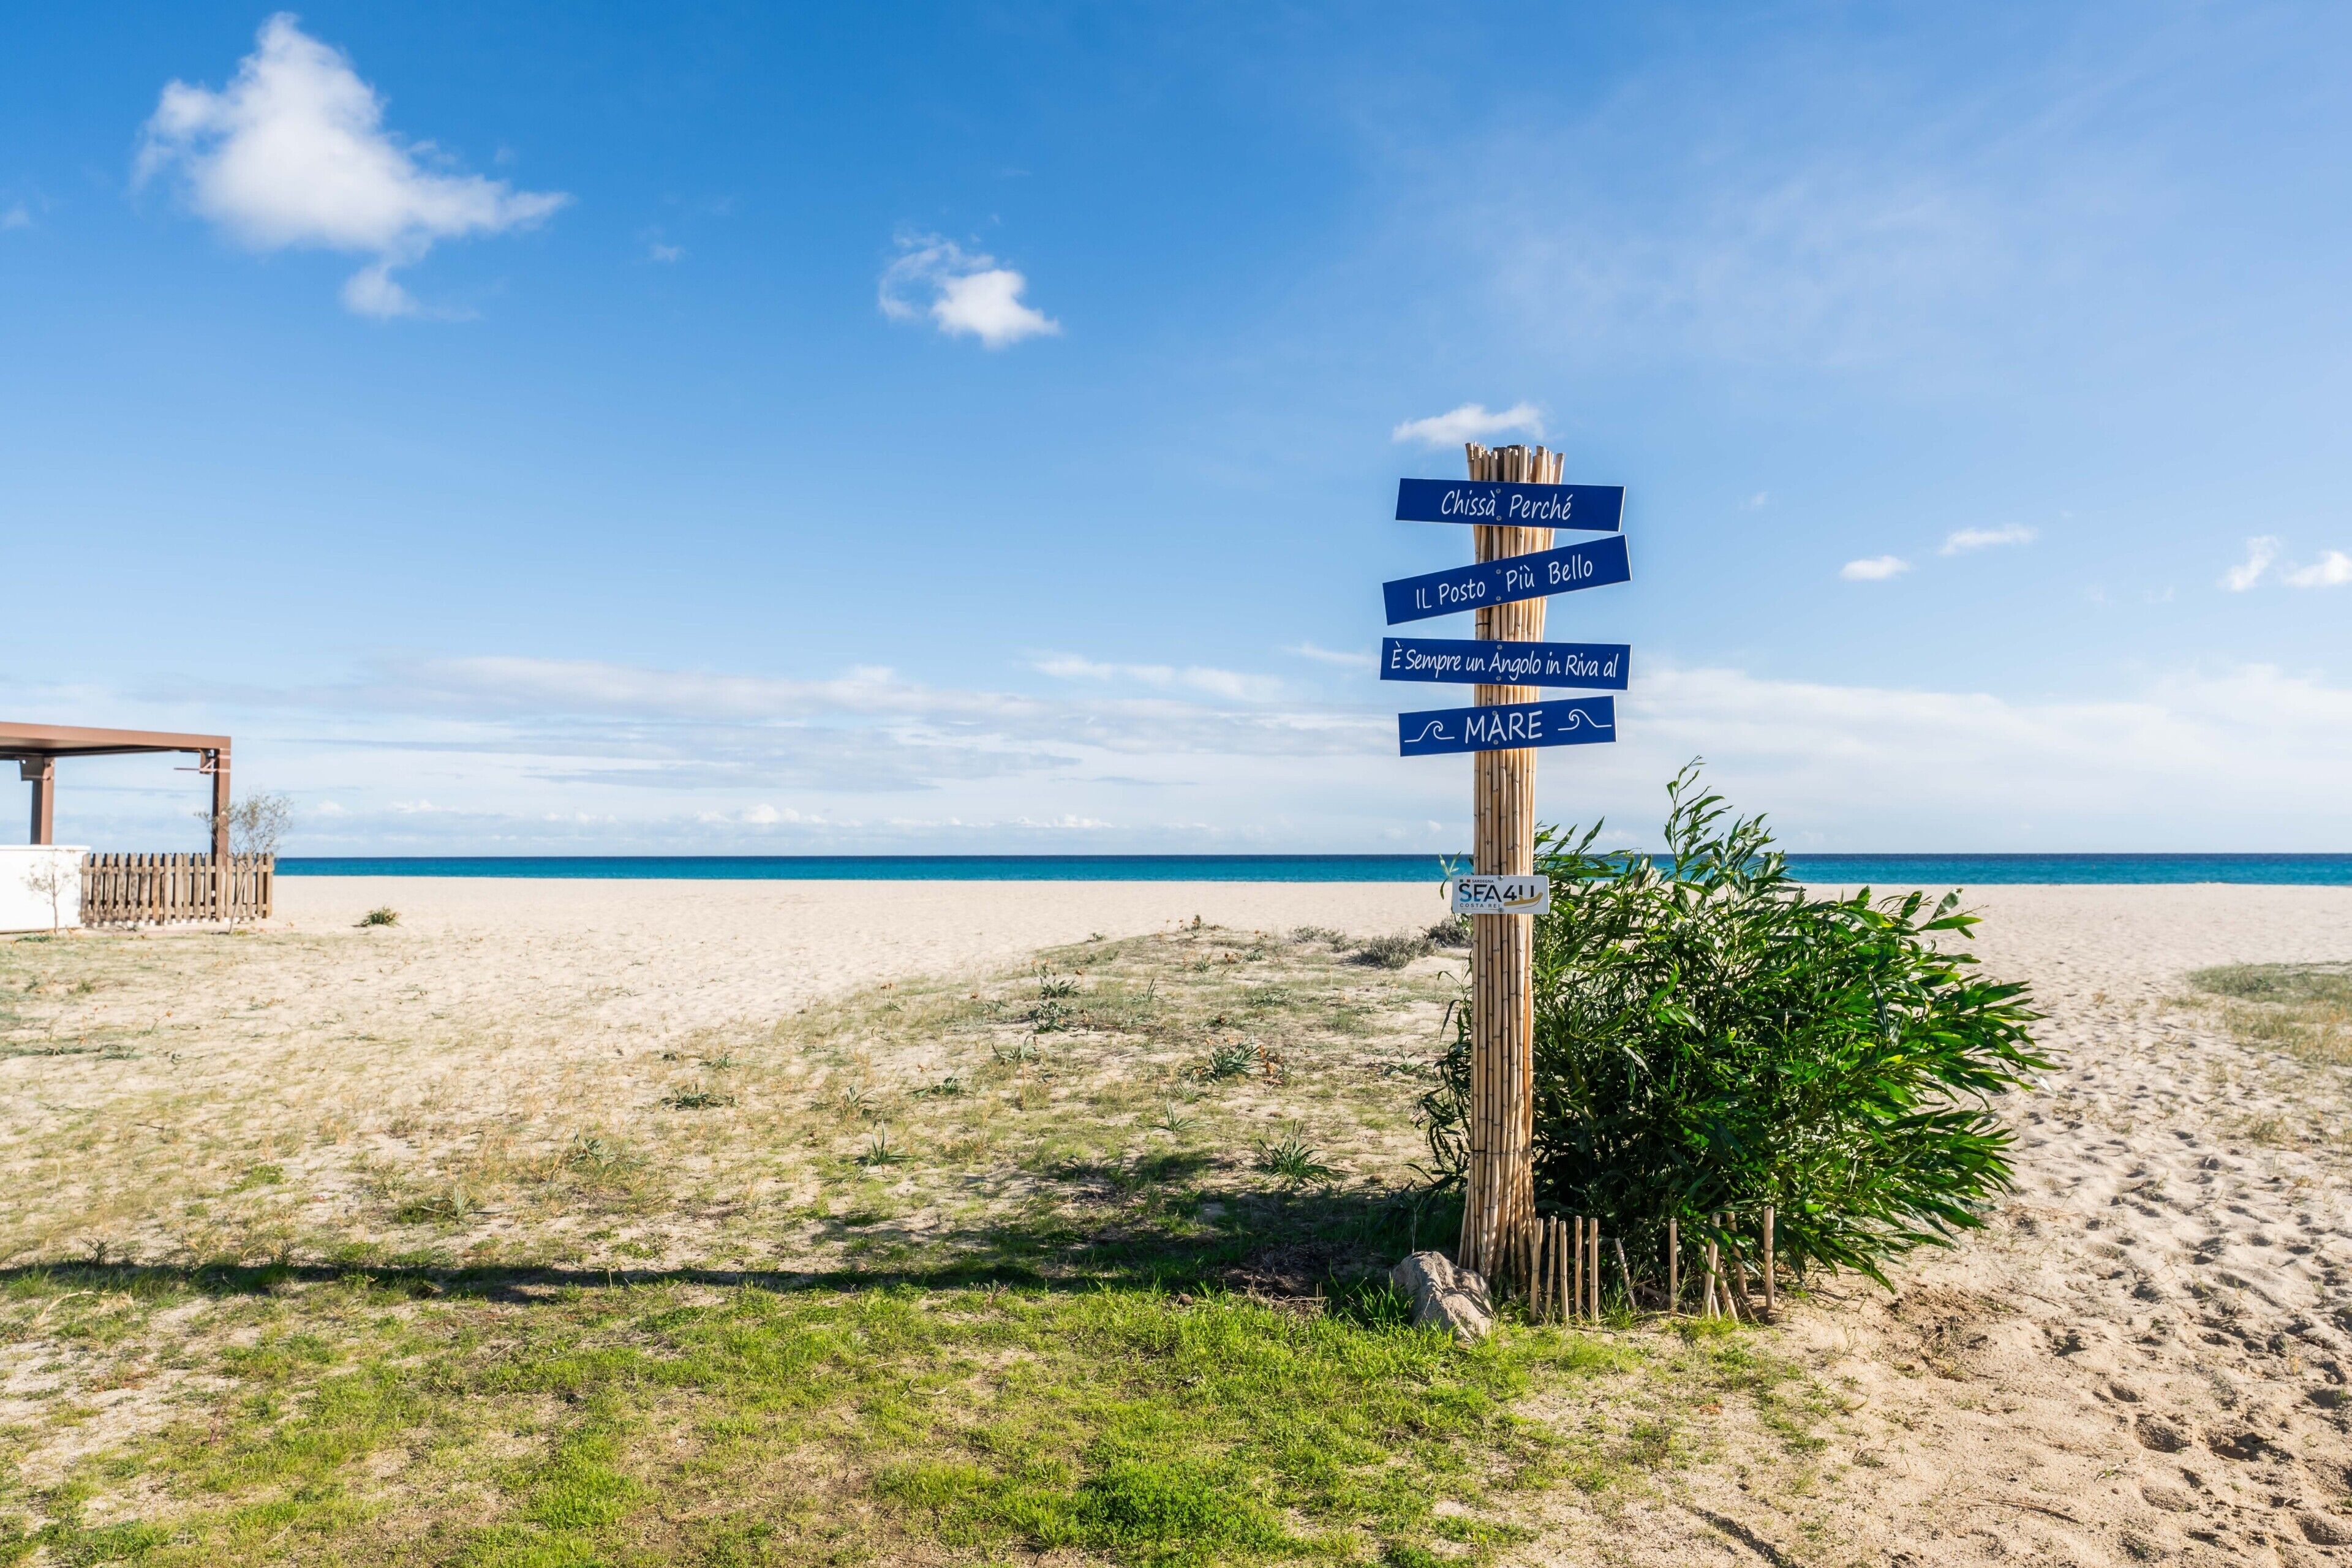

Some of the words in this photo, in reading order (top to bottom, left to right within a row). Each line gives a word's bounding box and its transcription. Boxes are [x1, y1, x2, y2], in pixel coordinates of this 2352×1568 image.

[1441, 489, 1496, 516] Chissà
[1509, 493, 1573, 521] Perché
[1416, 588, 1431, 609] IL
[1439, 578, 1485, 605] Posto
[1506, 565, 1535, 592] Più
[1548, 554, 1593, 585] Bello
[1391, 641, 1403, 669] È
[1405, 649, 1461, 678] Sempre
[1466, 655, 1485, 672] un
[1488, 652, 1541, 681] Angolo
[1546, 651, 1561, 675] in
[1565, 652, 1598, 677] Riva
[1603, 653, 1619, 678] al
[1464, 710, 1543, 744] MARE
